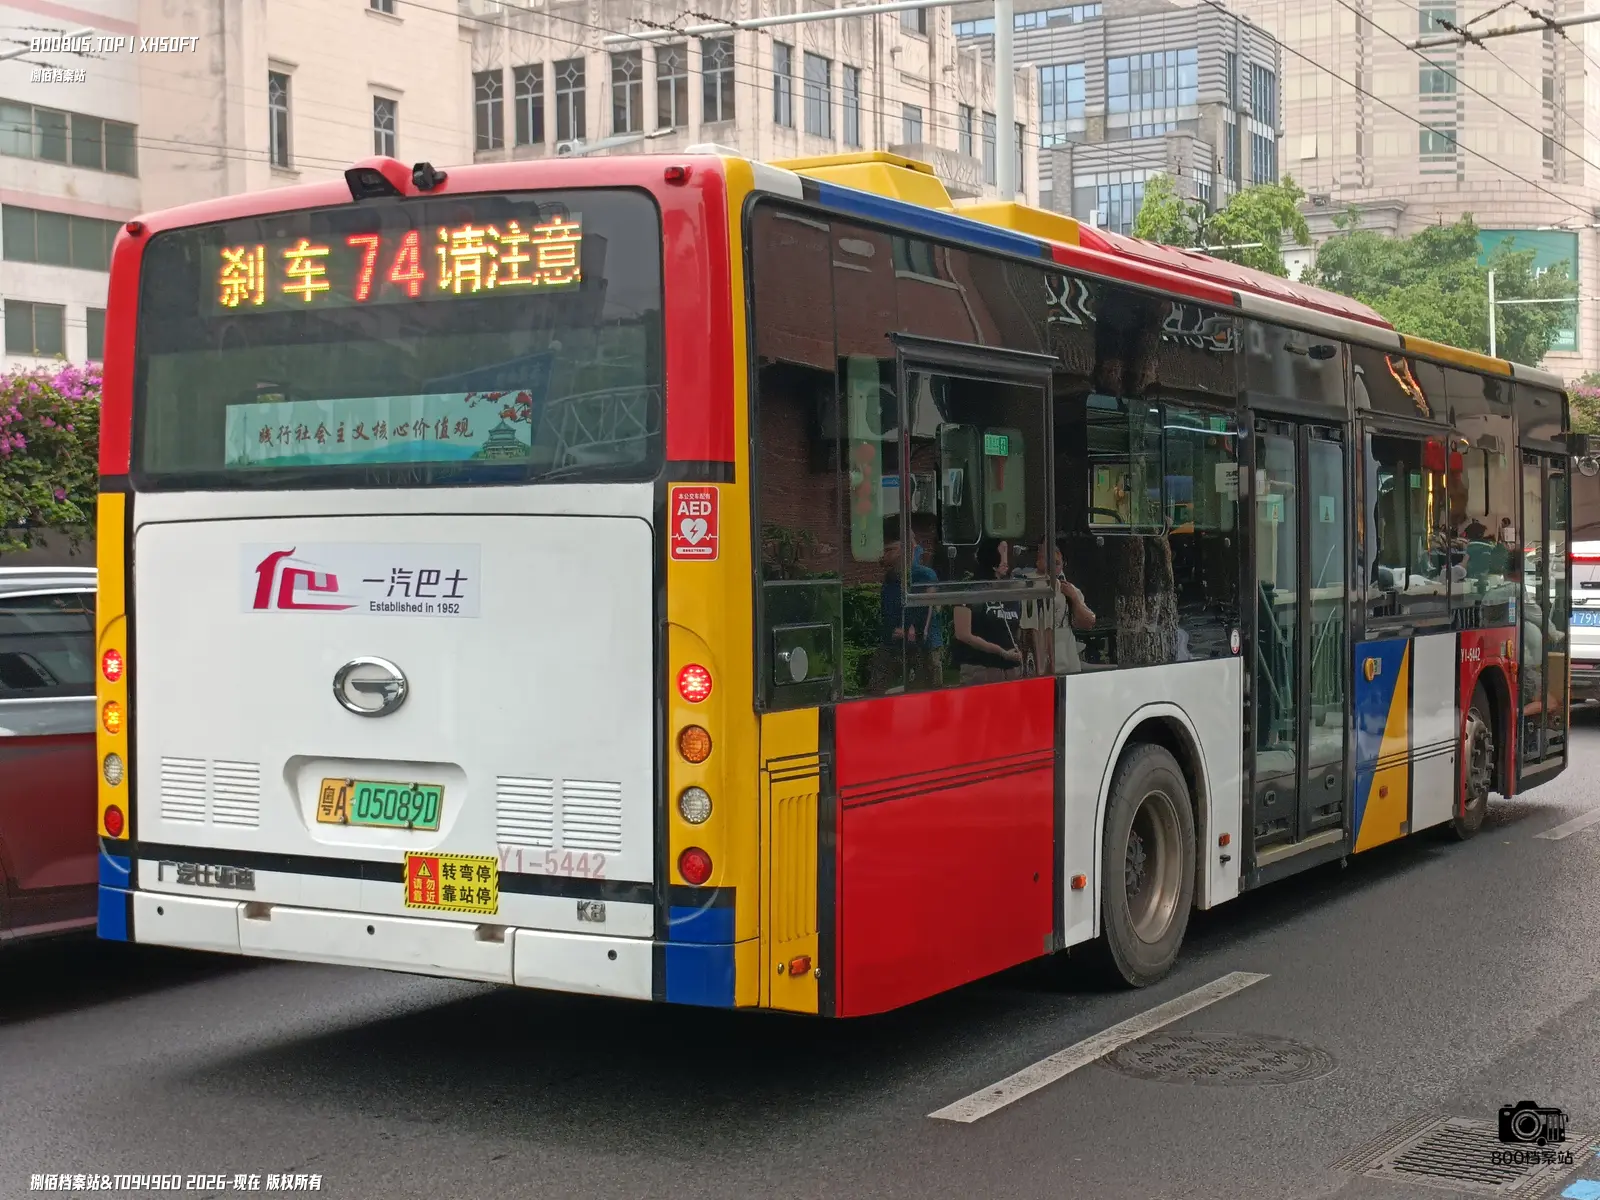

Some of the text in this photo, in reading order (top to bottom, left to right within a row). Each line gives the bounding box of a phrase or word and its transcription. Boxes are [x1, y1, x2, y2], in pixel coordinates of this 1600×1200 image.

[346, 230, 425, 301] 74
[436, 216, 583, 293] 请注意
[258, 416, 474, 447] 践行社会主义核心价值观
[677, 501, 712, 516] AED
[362, 568, 468, 598] 一汽巴士
[369, 601, 460, 614] Established in 1952
[442, 863, 491, 883] 转弯停
[497, 846, 606, 881] Y1-5442
[413, 878, 436, 890] 请勿
[442, 884, 491, 905] 靠站停
[577, 901, 606, 922] K8
